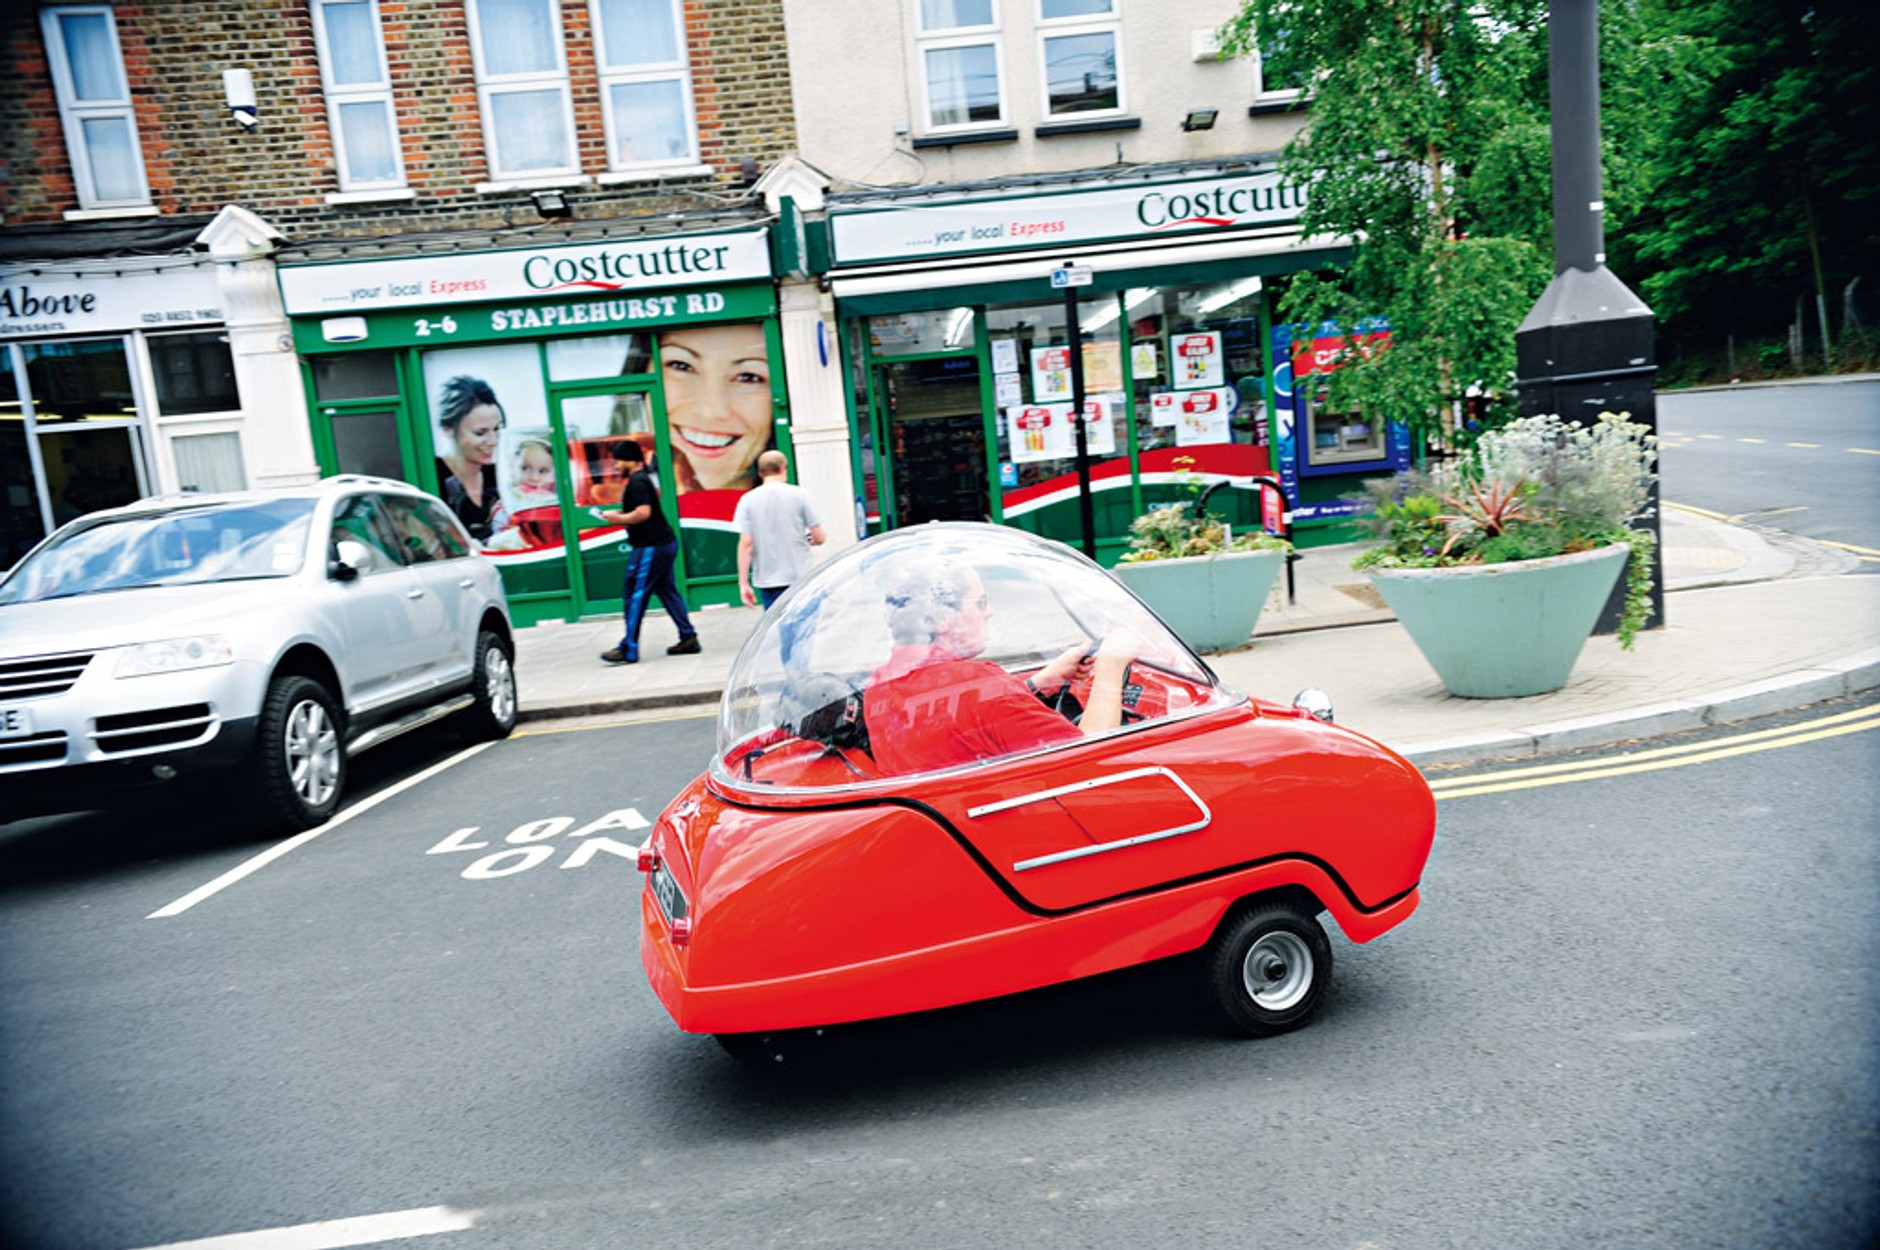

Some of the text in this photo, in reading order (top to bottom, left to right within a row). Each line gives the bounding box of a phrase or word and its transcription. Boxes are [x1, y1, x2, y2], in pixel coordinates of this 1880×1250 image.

[971, 224, 1004, 239] local
[1010, 220, 1065, 237] Express
[523, 245, 729, 290] Costcutter
[388, 281, 422, 296] local
[430, 279, 486, 294] Express
[0, 286, 96, 317] Above
[492, 292, 725, 330] STAPLEHURST RD
[414, 315, 458, 337] 2-6
